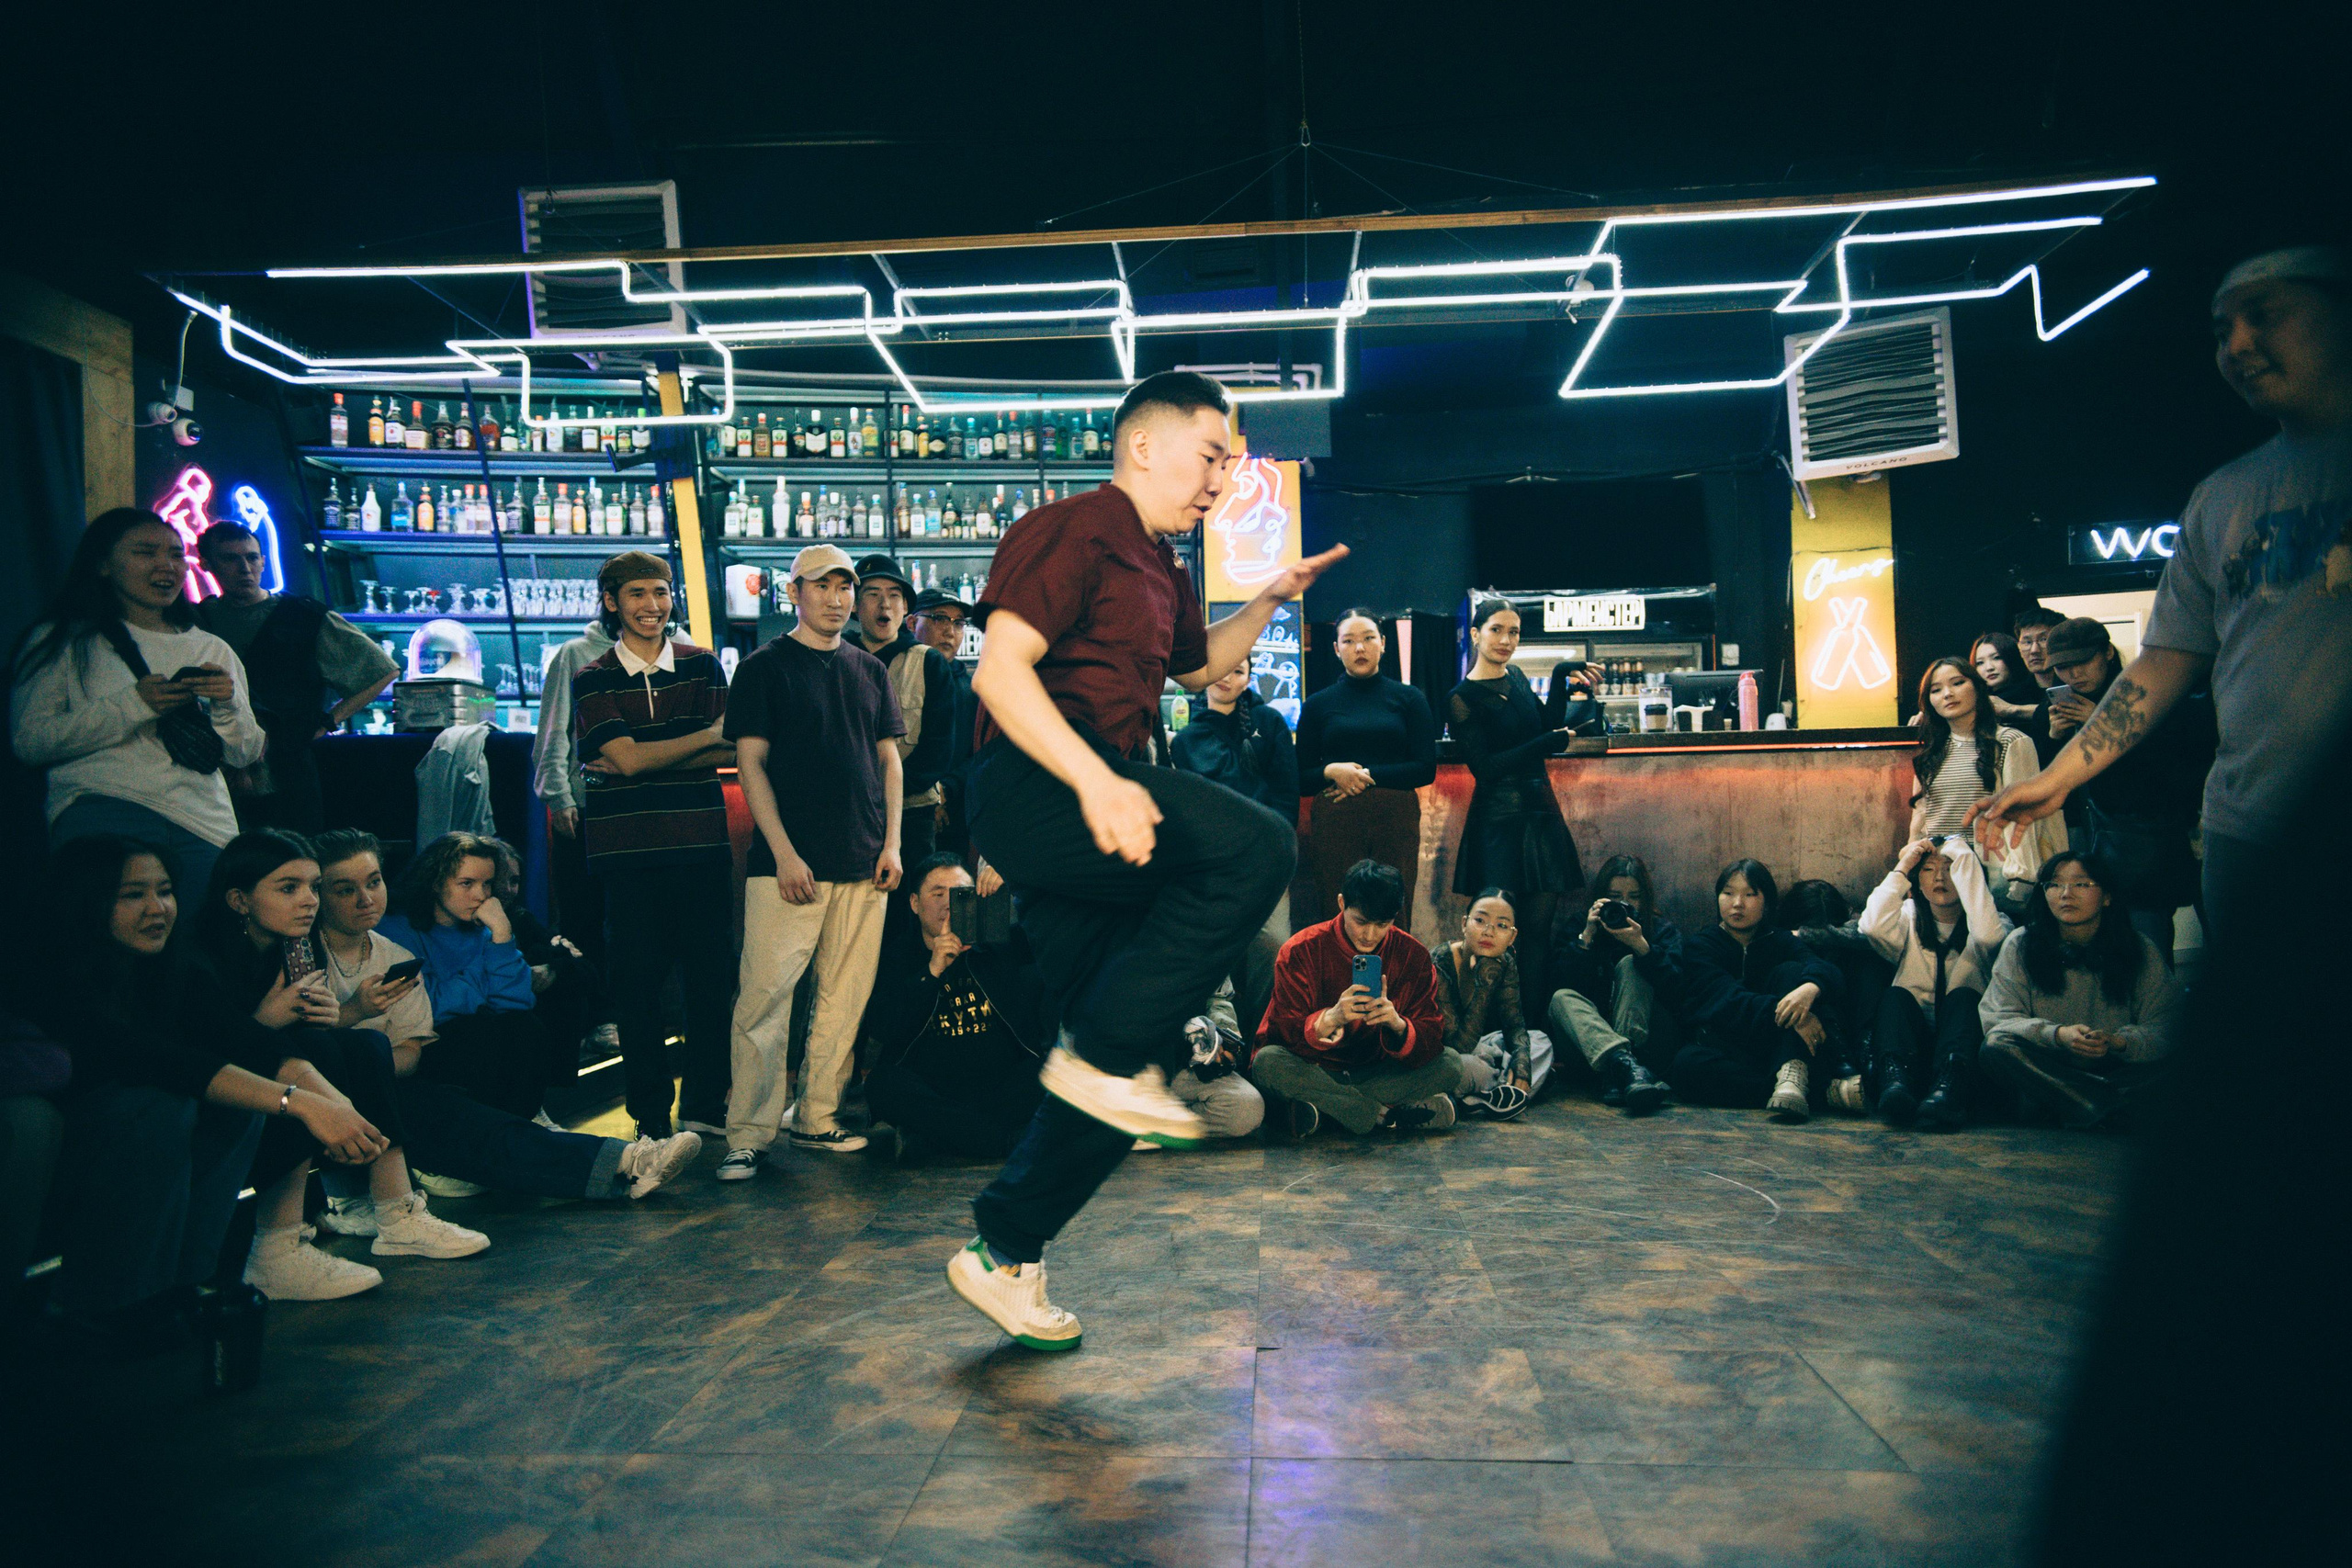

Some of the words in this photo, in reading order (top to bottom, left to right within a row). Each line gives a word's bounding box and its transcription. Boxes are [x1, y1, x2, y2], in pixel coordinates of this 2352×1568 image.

[1846, 457, 1907, 469] VOLCANO
[2090, 525, 2180, 559] WC
[1804, 558, 1894, 601] Cheers
